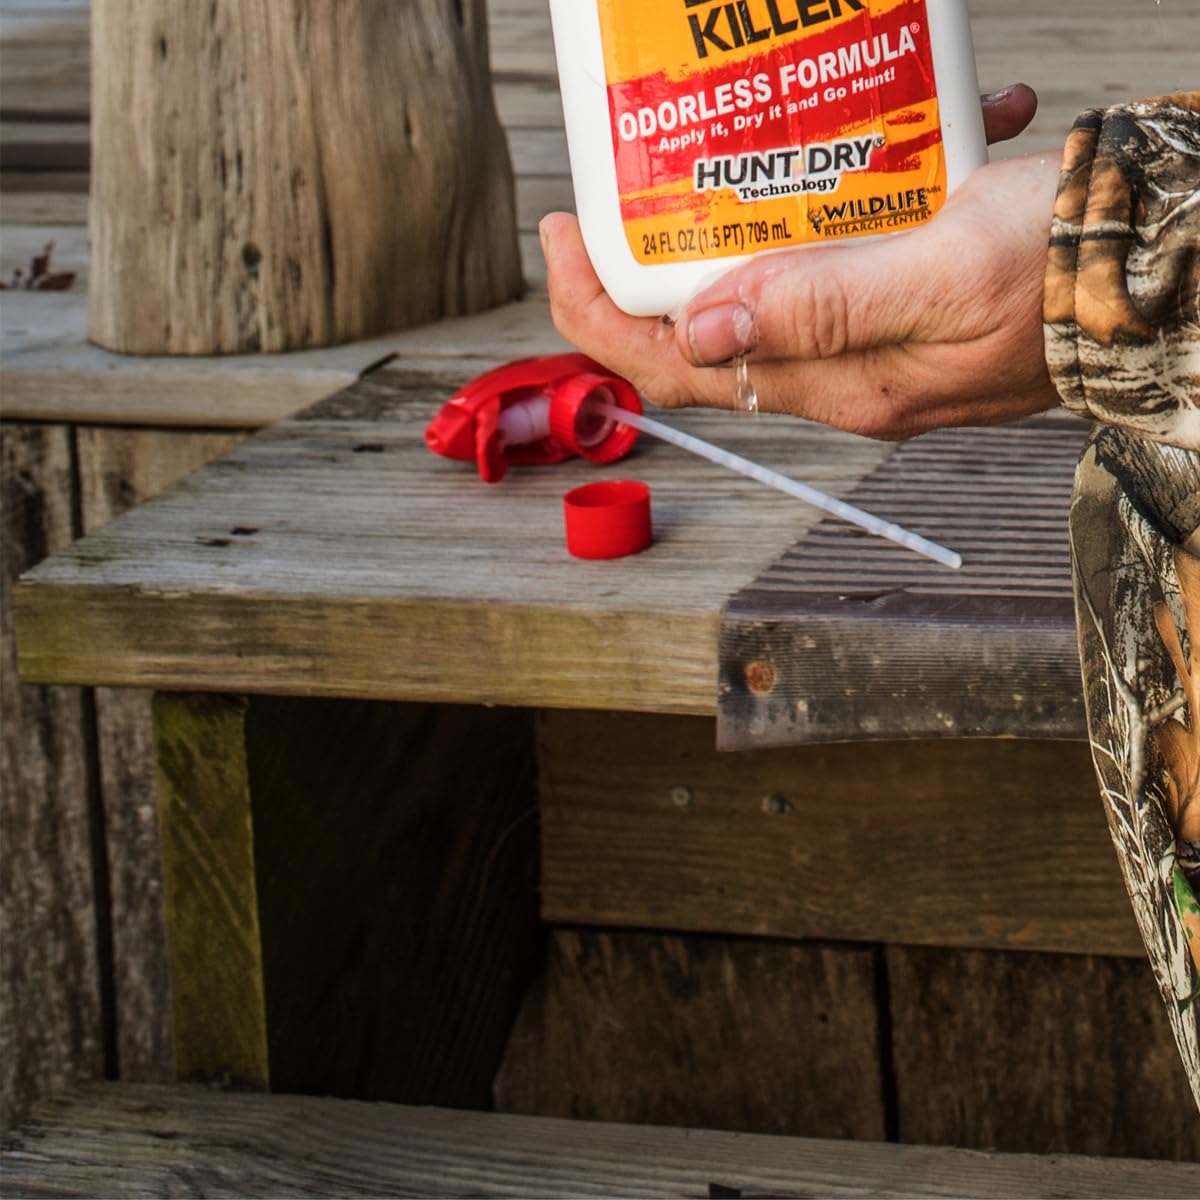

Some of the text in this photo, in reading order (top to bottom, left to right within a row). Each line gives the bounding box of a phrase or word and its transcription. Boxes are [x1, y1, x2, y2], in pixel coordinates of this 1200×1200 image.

[618, 73, 772, 142] ODORLESS
[658, 128, 706, 153] Apply
[710, 122, 729, 138] it,
[733, 109, 765, 130] Dry
[786, 95, 819, 114] and
[823, 86, 847, 103] Go
[851, 66, 896, 92] Hunt!
[696, 150, 799, 189] HUNT
[739, 177, 838, 199] Technology
[822, 187, 929, 222] WILDLIFE
[642, 217, 792, 255] 24 FL OZ (1.5 PT) 709 mL
[823, 220, 884, 237] RESEARCH
